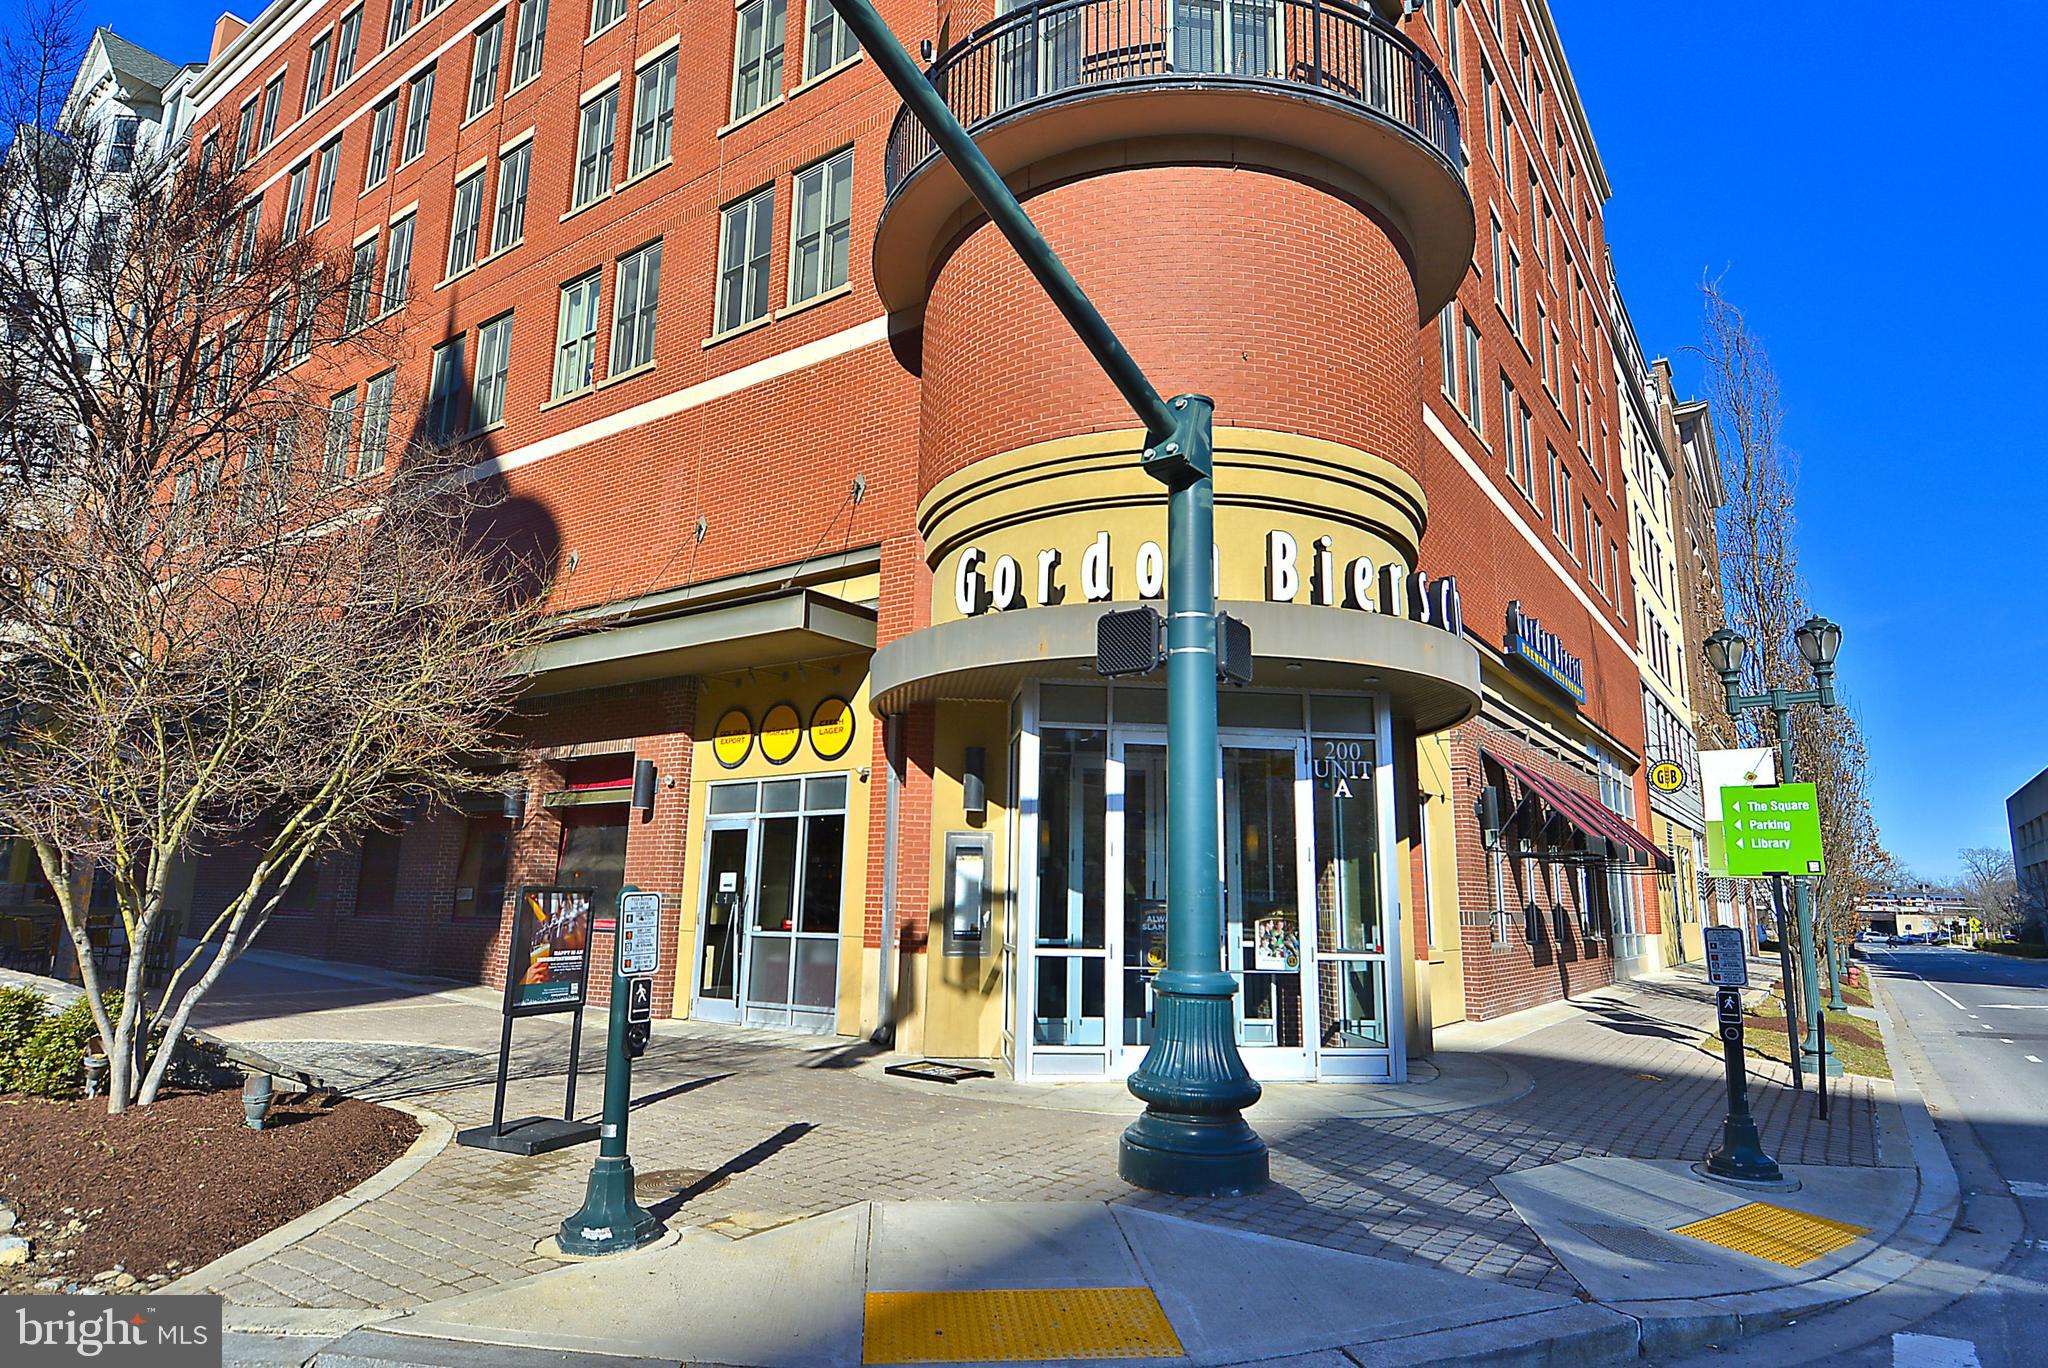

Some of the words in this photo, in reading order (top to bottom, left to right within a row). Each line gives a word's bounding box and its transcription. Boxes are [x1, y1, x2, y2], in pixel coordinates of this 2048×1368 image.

[955, 530, 1220, 615] Gordo
[1266, 529, 1463, 639] Biersch
[818, 726, 844, 736] LAGER
[720, 736, 746, 745] EXPORT
[1324, 741, 1361, 760] 200
[1313, 759, 1373, 779] UNIT
[1334, 778, 1353, 798] A
[1746, 800, 1768, 812] The
[1770, 799, 1810, 813] Square
[1749, 819, 1791, 832] Parking
[1751, 837, 1791, 850] Library
